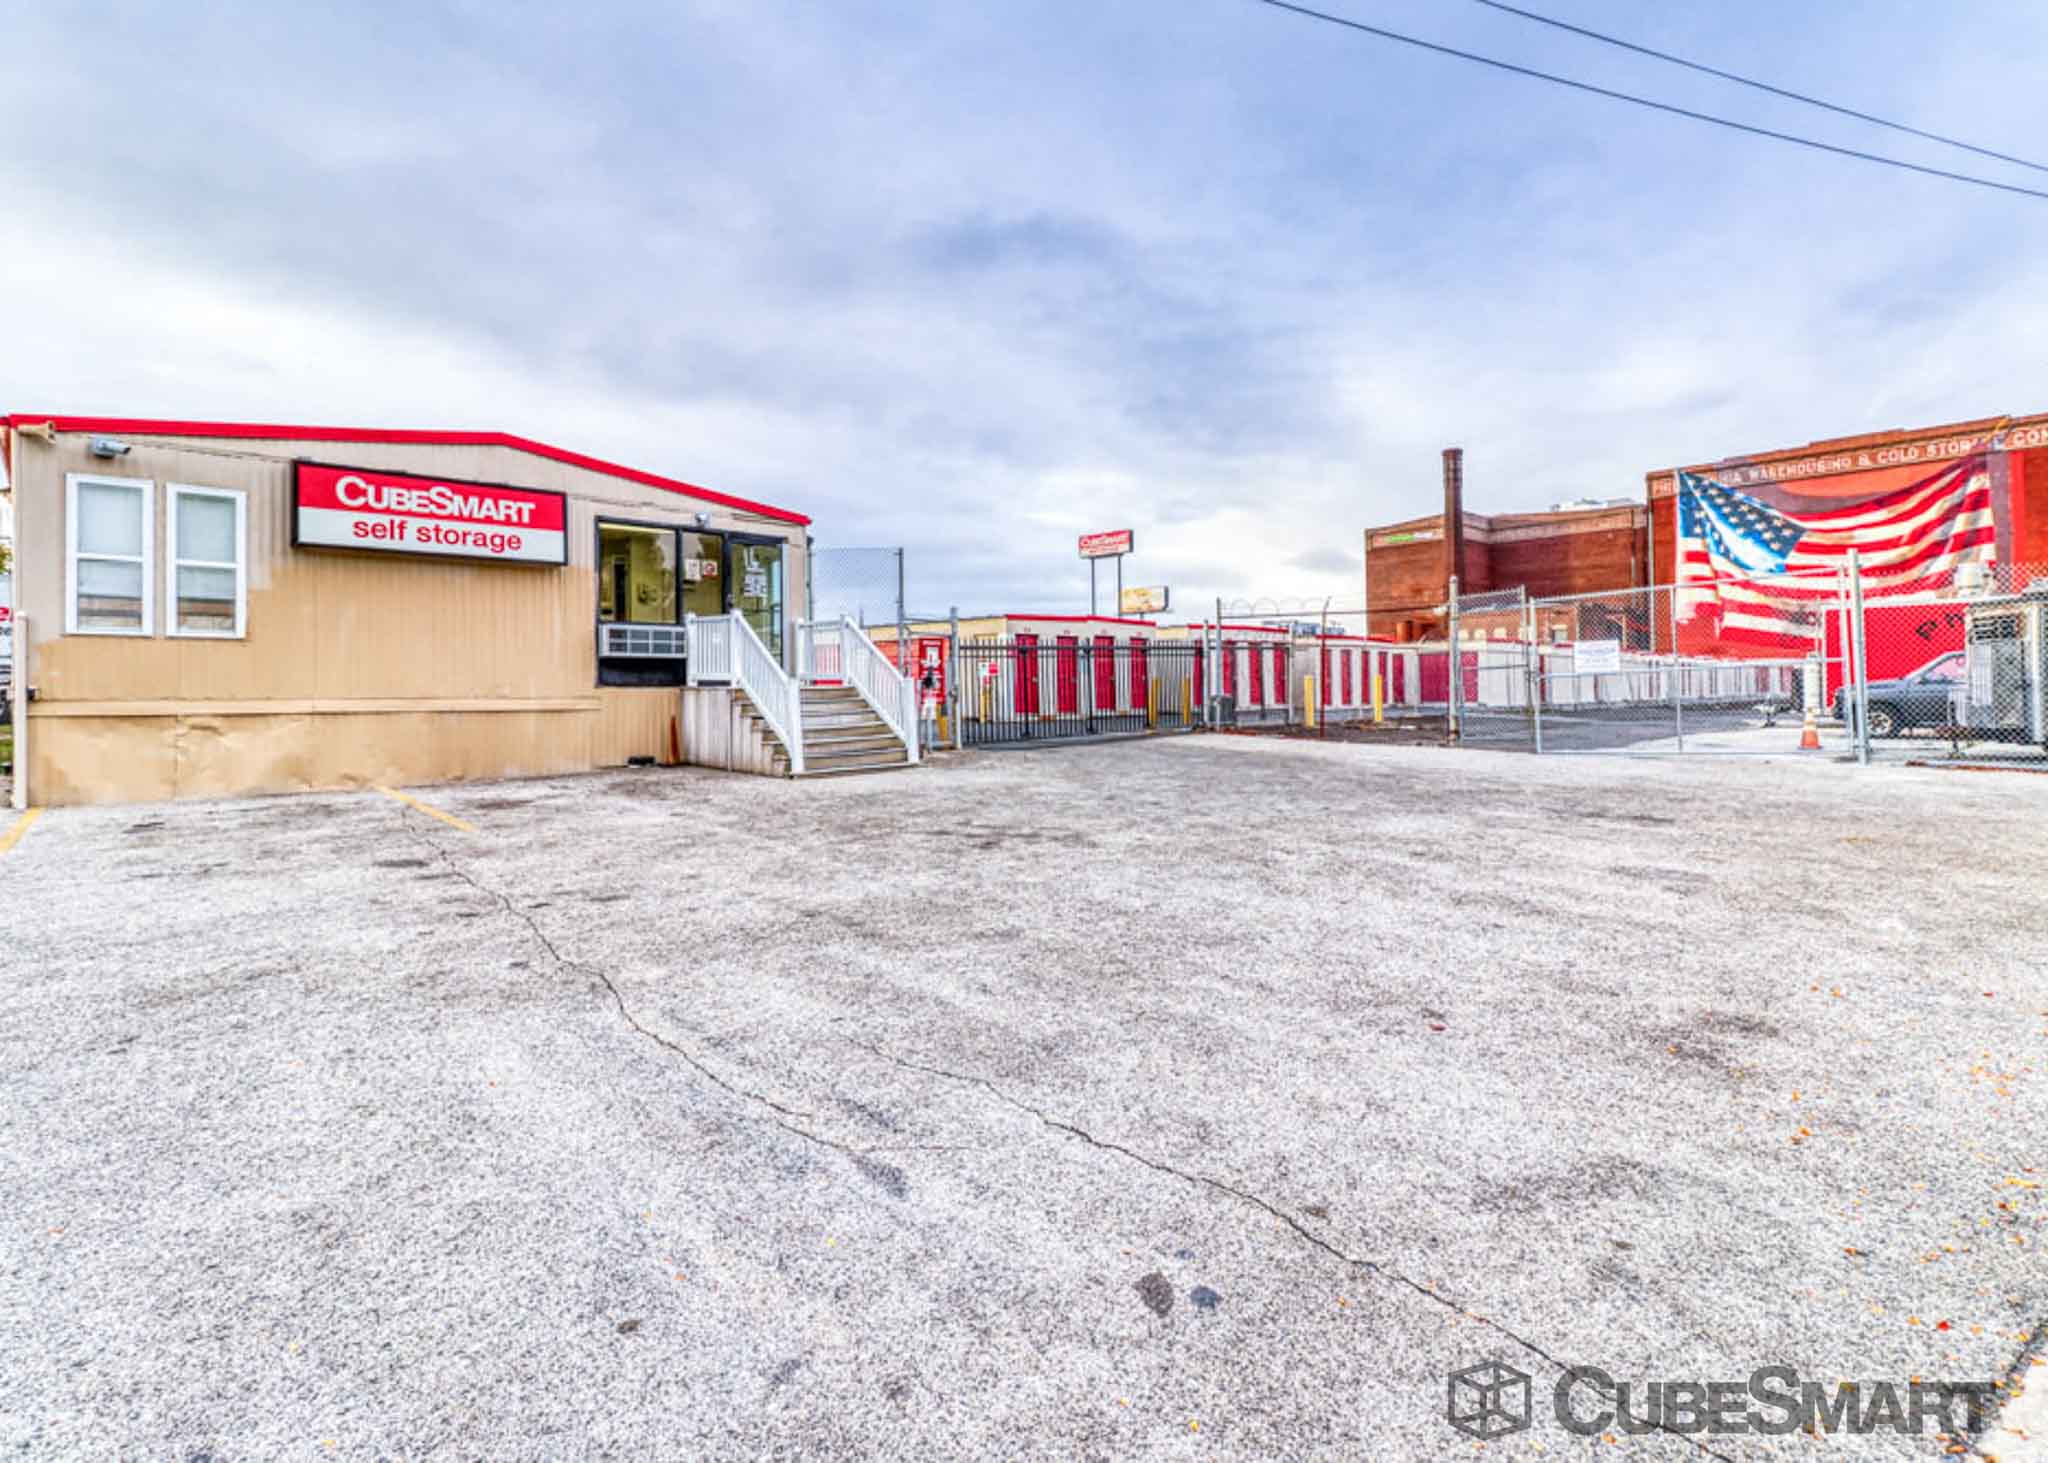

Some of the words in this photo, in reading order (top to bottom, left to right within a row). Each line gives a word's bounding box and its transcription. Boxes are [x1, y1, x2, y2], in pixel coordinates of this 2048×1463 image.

[1877, 447, 1919, 464] COLD
[353, 518, 408, 541] self
[416, 524, 522, 553] storage
